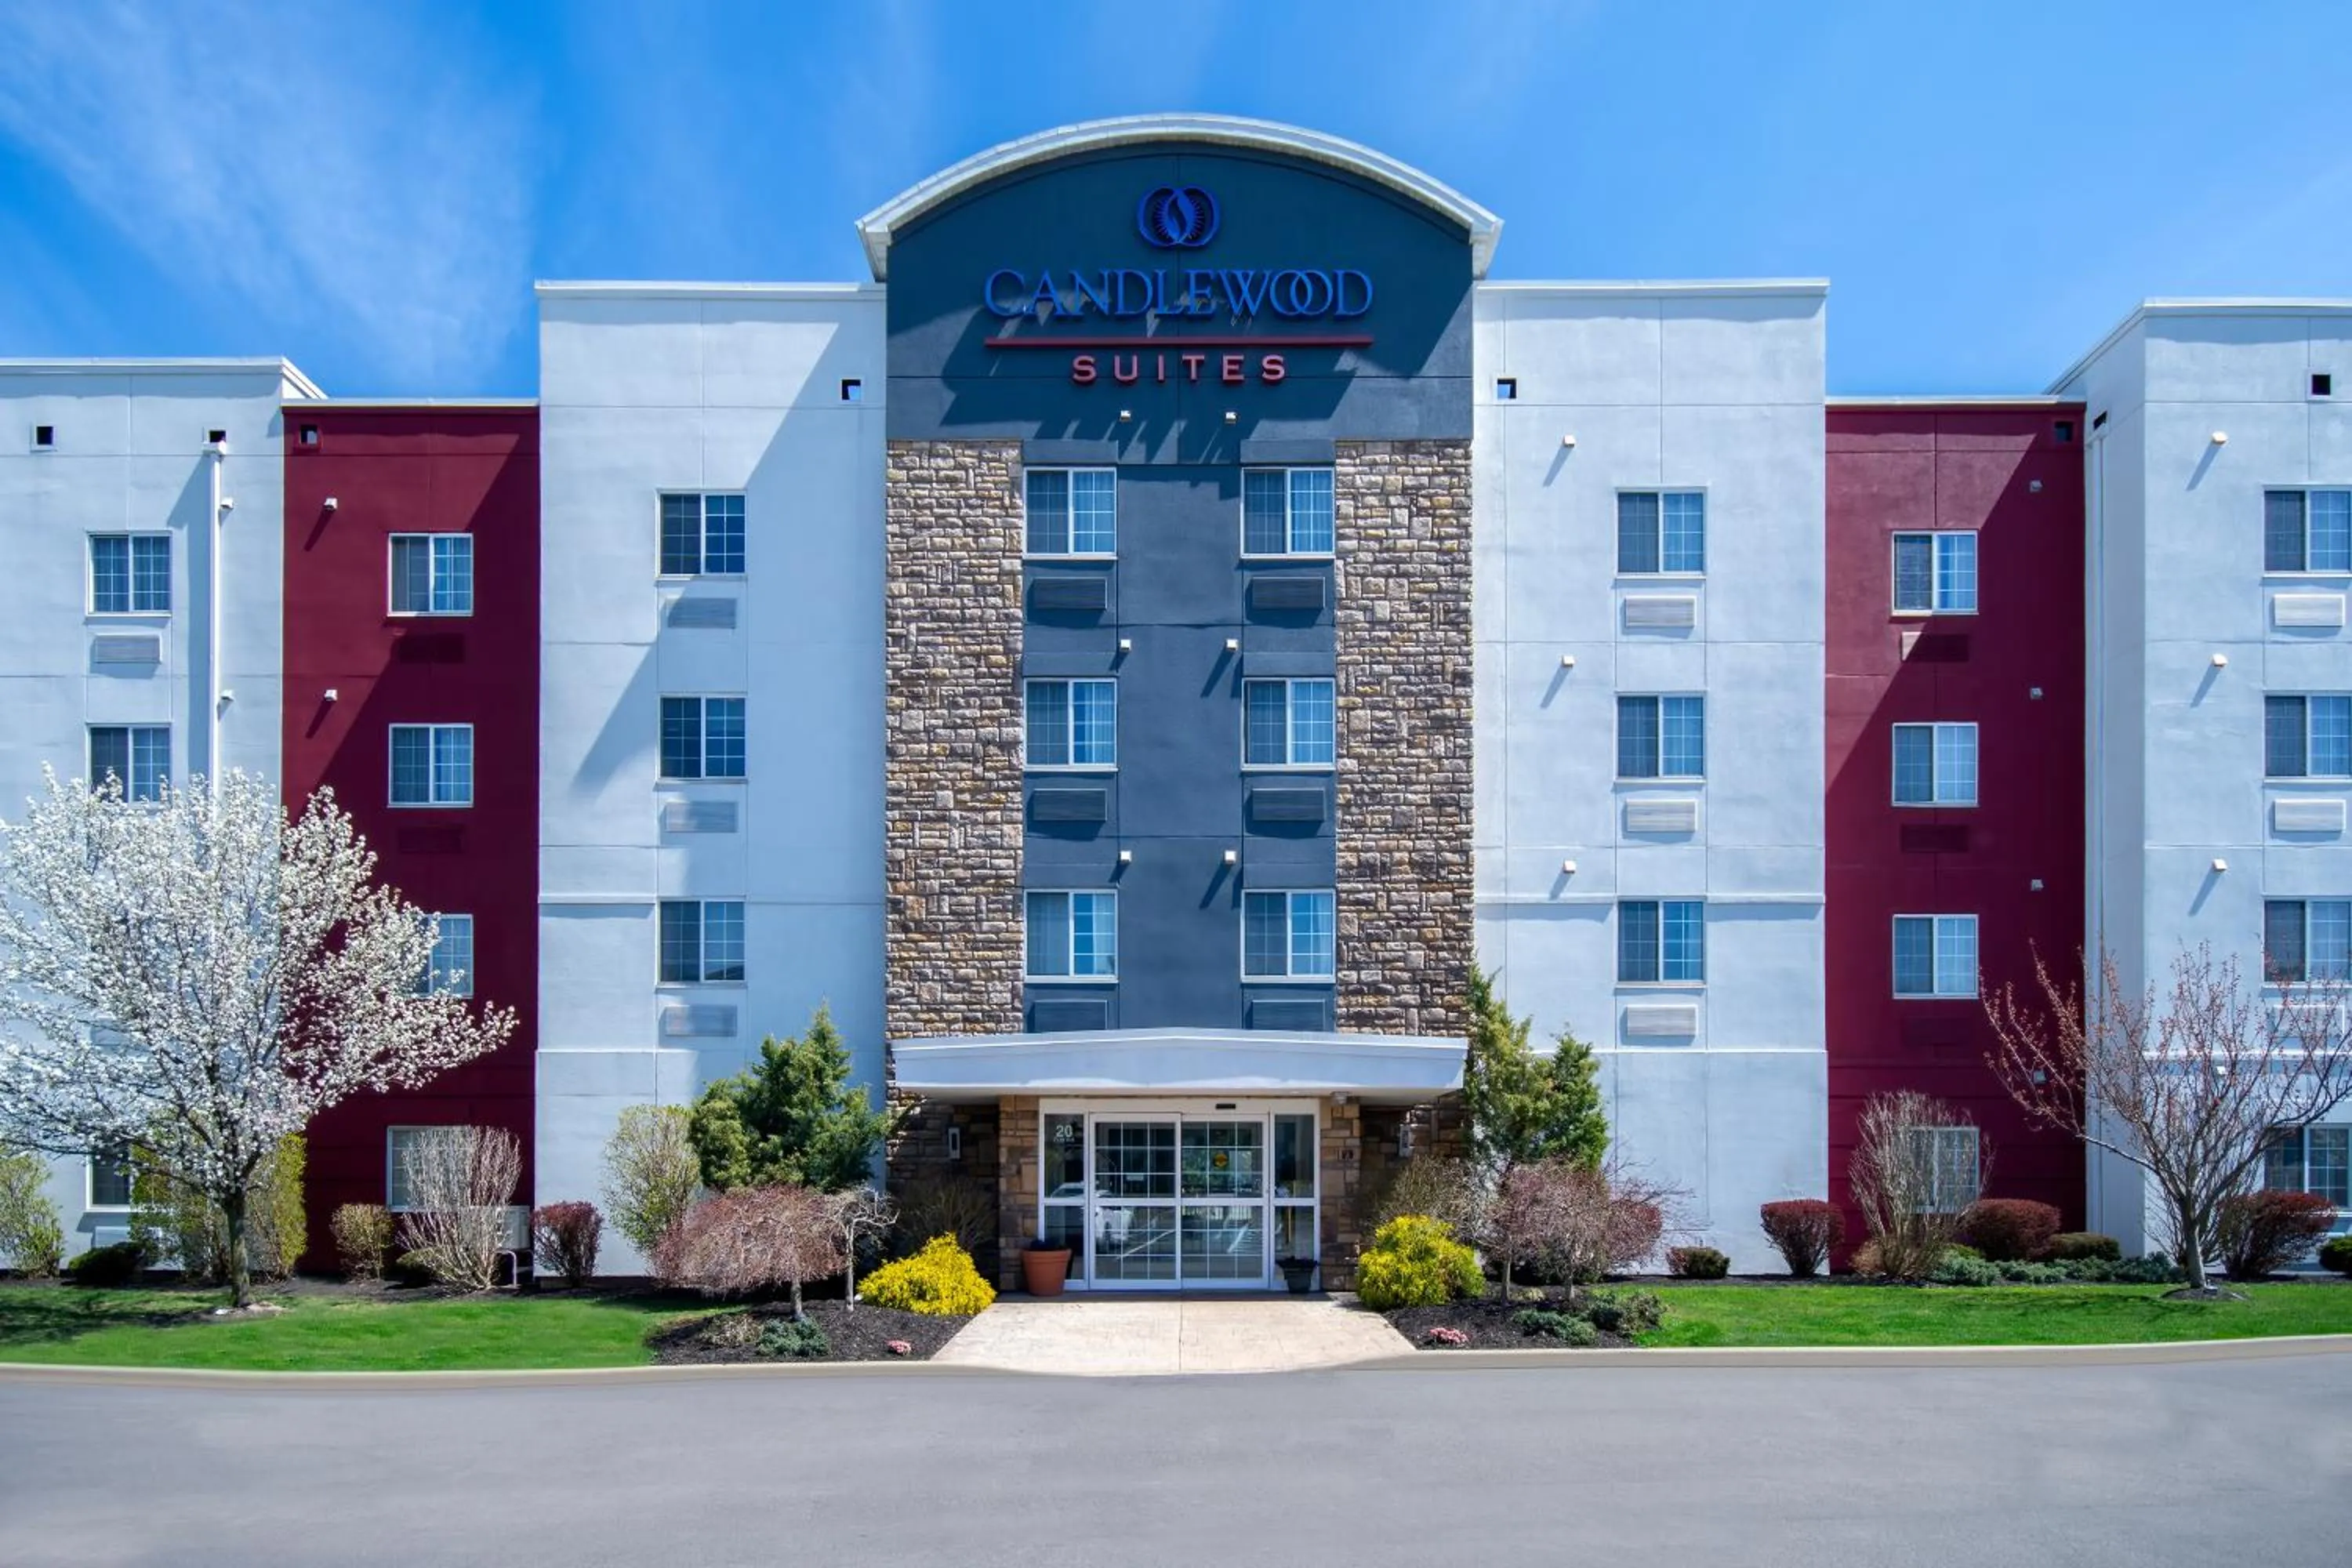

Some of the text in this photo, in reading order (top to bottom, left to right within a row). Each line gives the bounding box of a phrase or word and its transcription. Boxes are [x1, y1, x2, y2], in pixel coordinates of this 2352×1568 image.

[984, 268, 1374, 316] CANDLEWOOD
[1072, 354, 1287, 383] SUITES
[1056, 1124, 1073, 1138] 20
